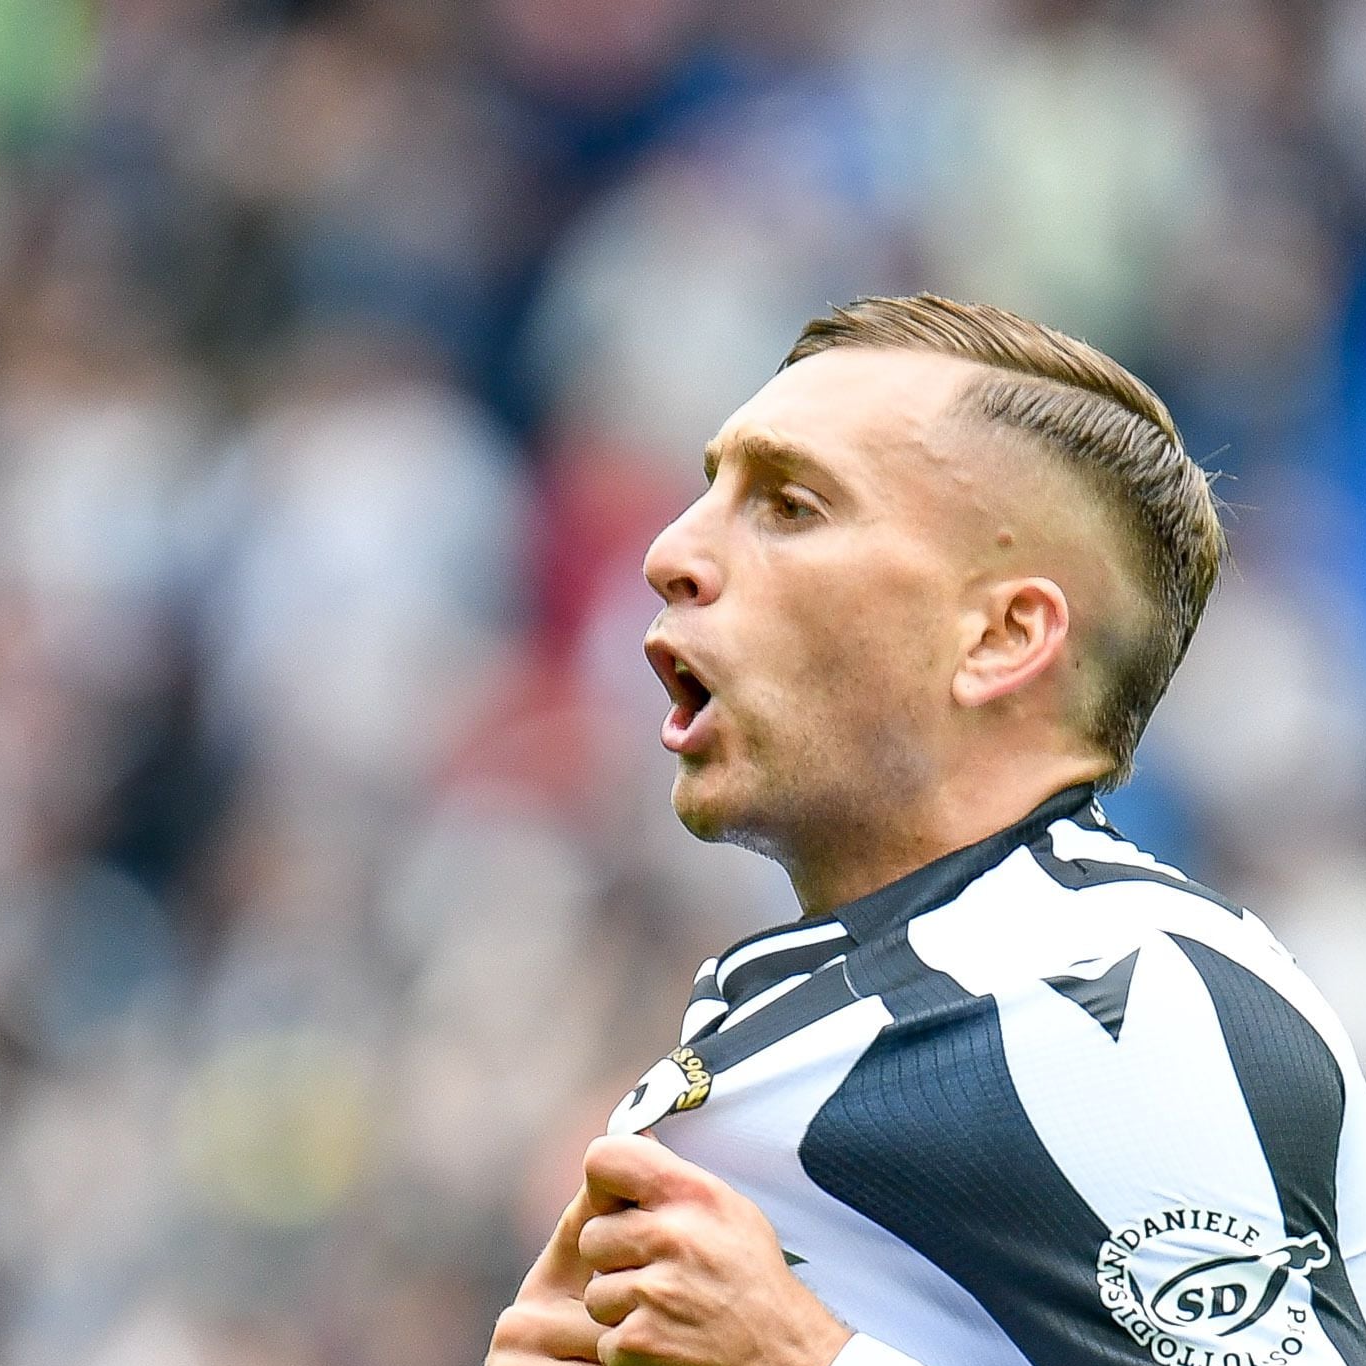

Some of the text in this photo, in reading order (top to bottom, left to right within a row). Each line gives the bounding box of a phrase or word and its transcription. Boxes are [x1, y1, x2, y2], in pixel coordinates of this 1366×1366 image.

[1118, 1209, 1261, 1251] DANIELE
[1103, 1248, 1128, 1303] SAN
[1176, 1283, 1248, 1323] SD
[1118, 1307, 1154, 1341] DI
